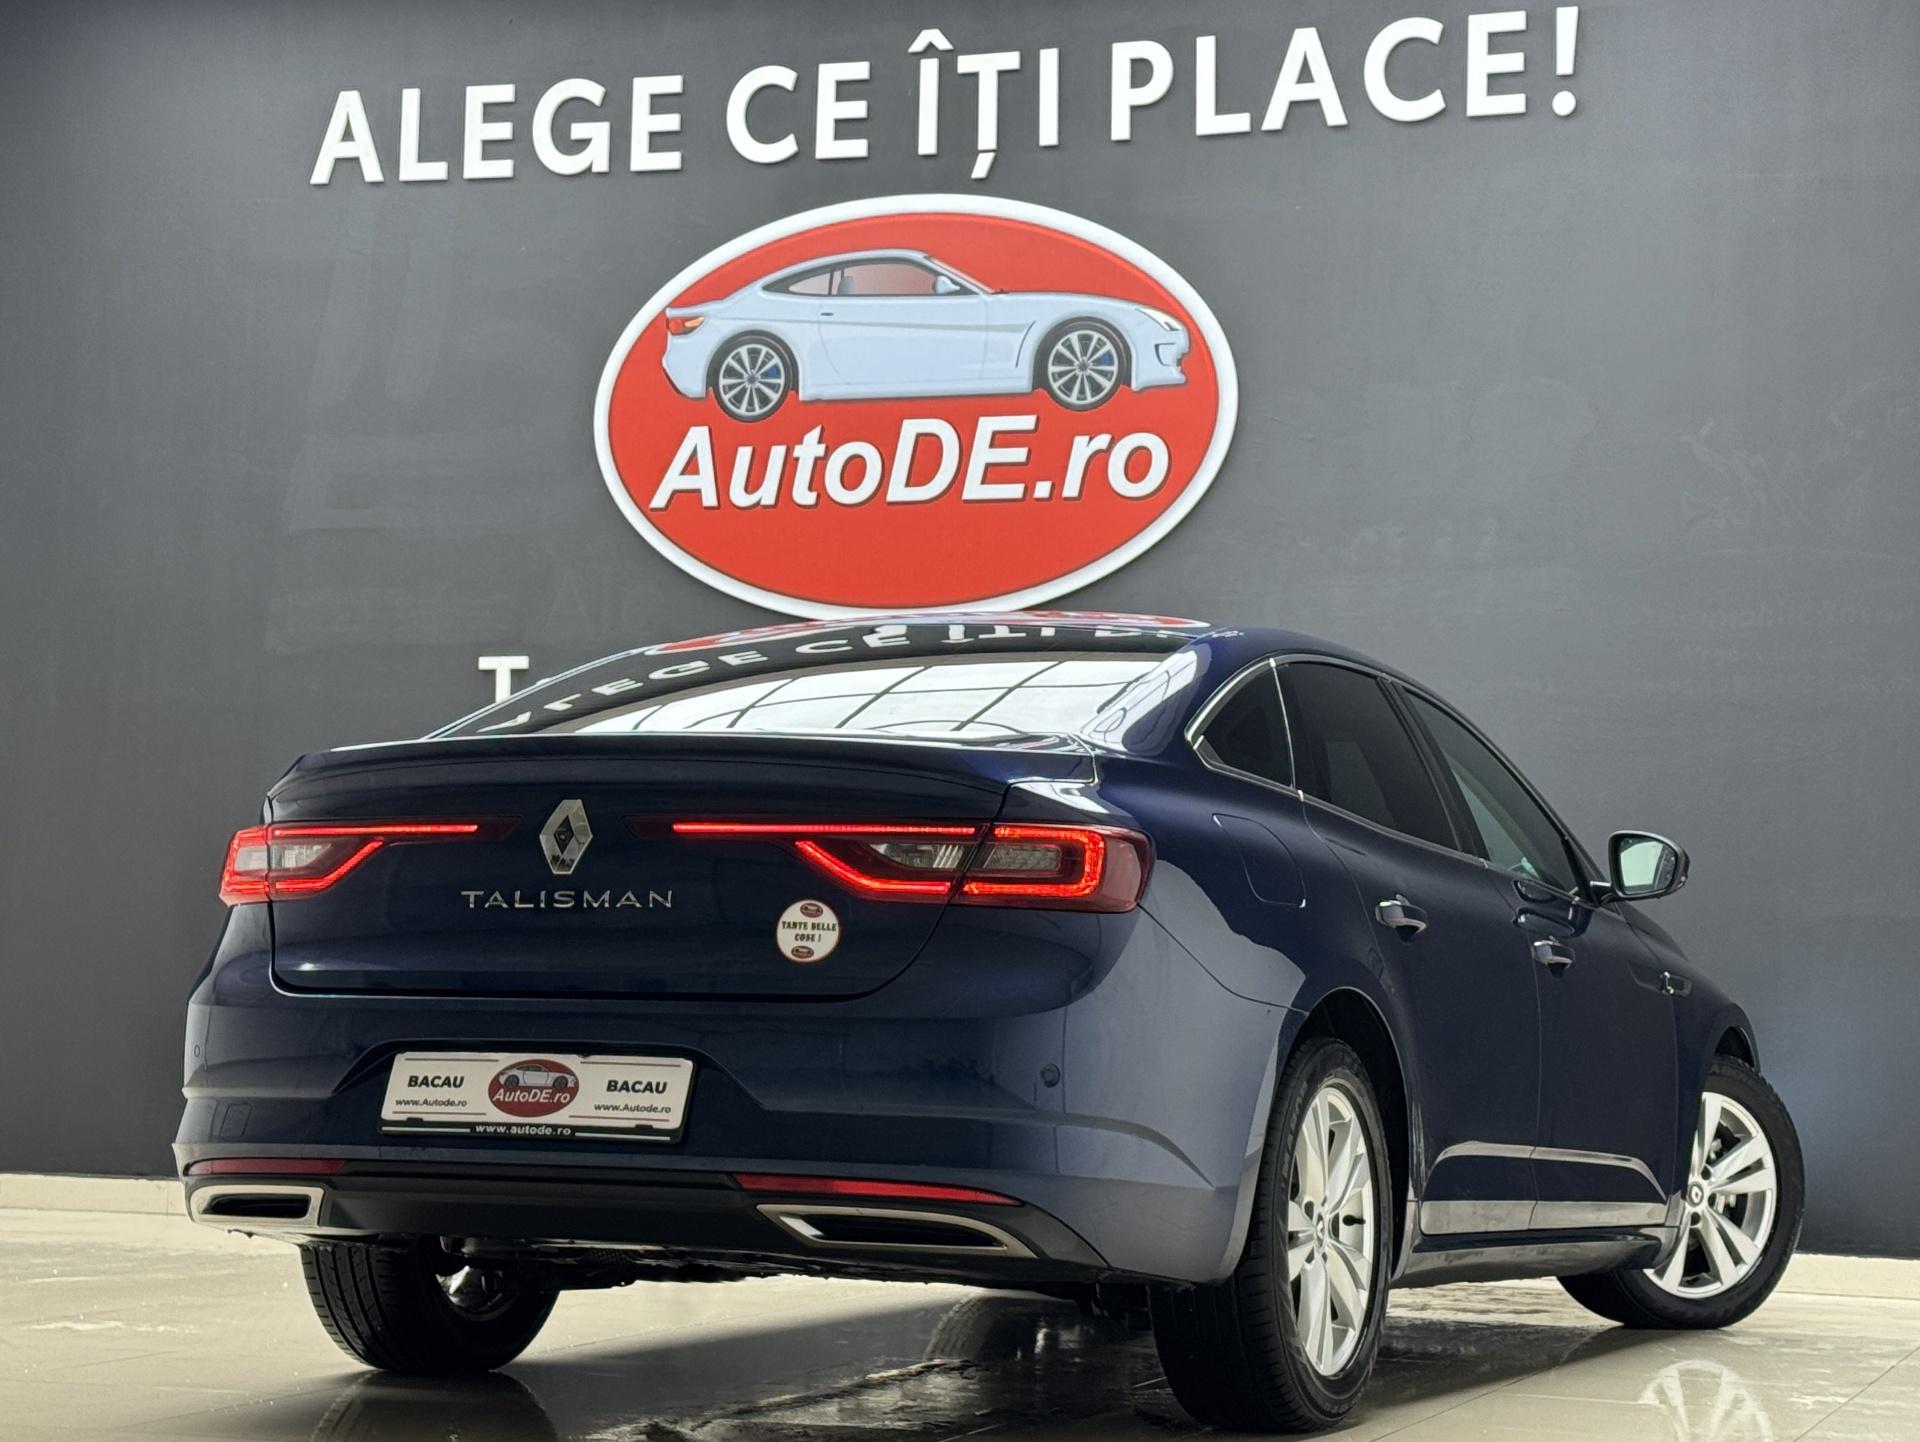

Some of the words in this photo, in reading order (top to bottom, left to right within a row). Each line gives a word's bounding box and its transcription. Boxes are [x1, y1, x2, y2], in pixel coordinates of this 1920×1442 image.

[309, 74, 682, 184] ALEGE
[725, 62, 871, 164] CE
[1109, 5, 1579, 140] PLACE!
[649, 414, 1171, 511] AutoDE.ro
[460, 889, 674, 909] TALISMAN
[407, 1075, 465, 1089] BACAU
[606, 1079, 668, 1094] BACAU
[395, 1098, 468, 1108] www.Autode.ro
[492, 1088, 571, 1104] AutoDE.ro
[594, 1103, 672, 1114] www.Autode.ro
[475, 1124, 572, 1136] www.autode.ro
